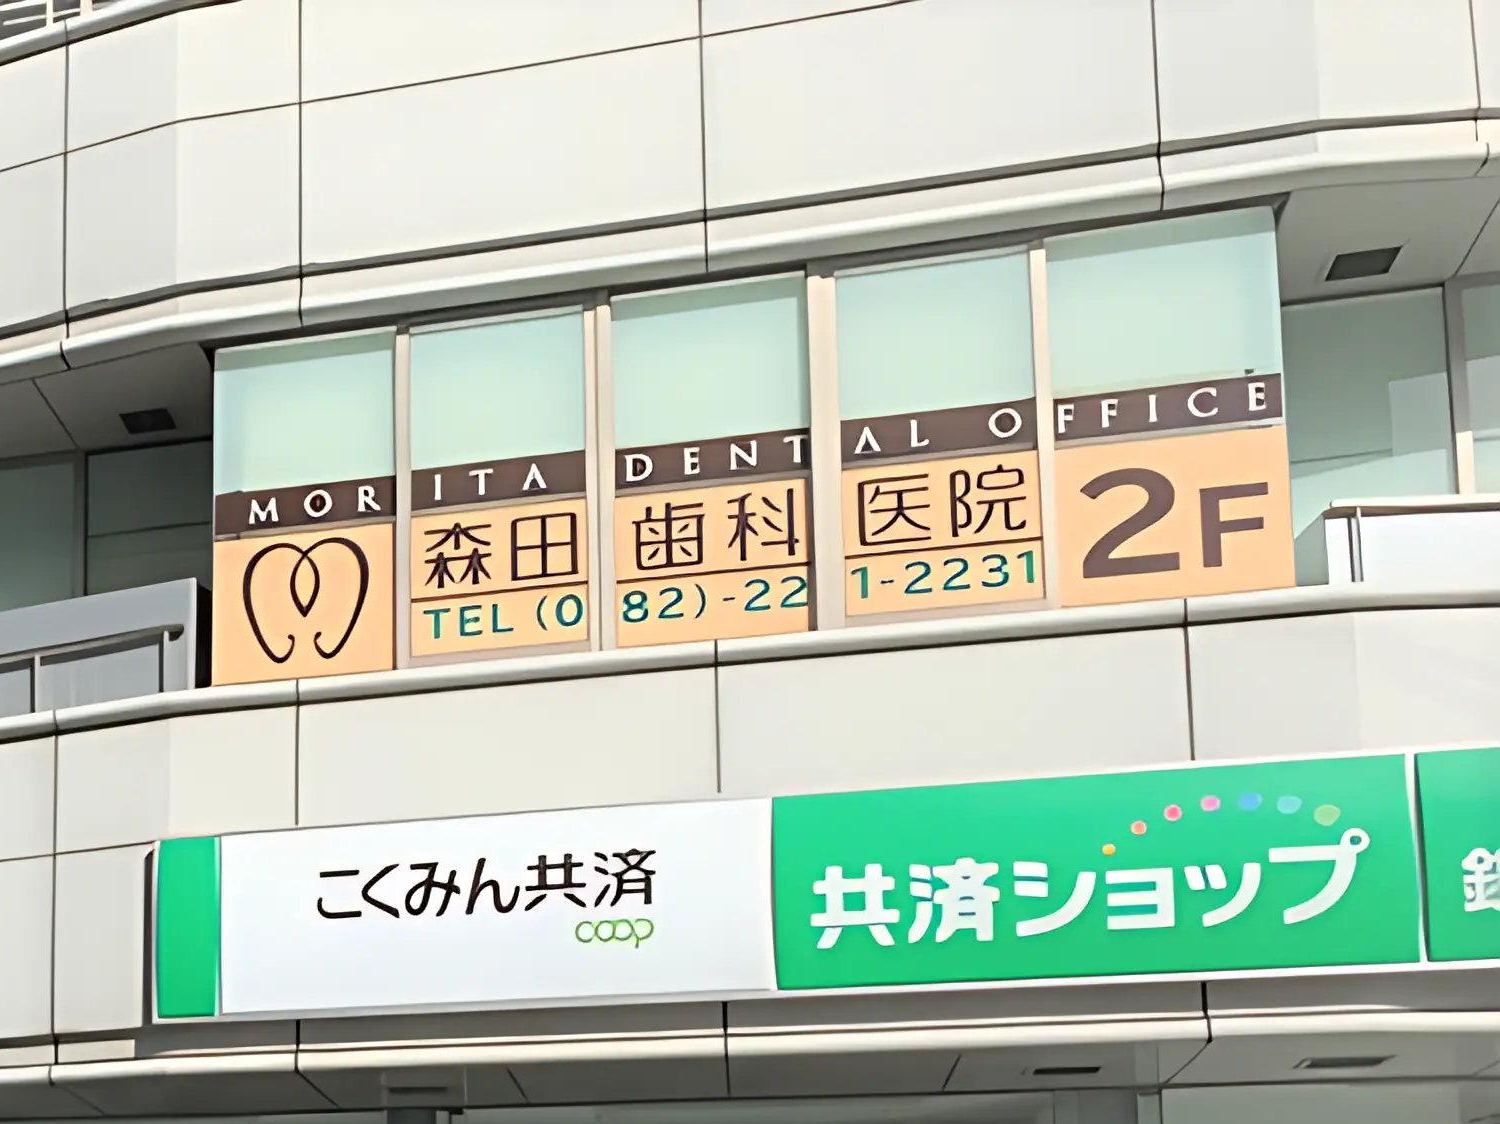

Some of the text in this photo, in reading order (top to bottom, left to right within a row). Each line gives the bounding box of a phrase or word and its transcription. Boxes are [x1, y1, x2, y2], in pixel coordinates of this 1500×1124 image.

[247, 381, 1269, 526] MORITA DENTAL OFFICE
[422, 463, 1029, 589] 森田歯科医院
[1078, 466, 1270, 579] 2F
[421, 549, 1038, 640] TEL (082)-221-2231
[316, 847, 657, 920] こくみん共済
[574, 917, 655, 949] coop
[809, 827, 1371, 950] 共済ショップ
